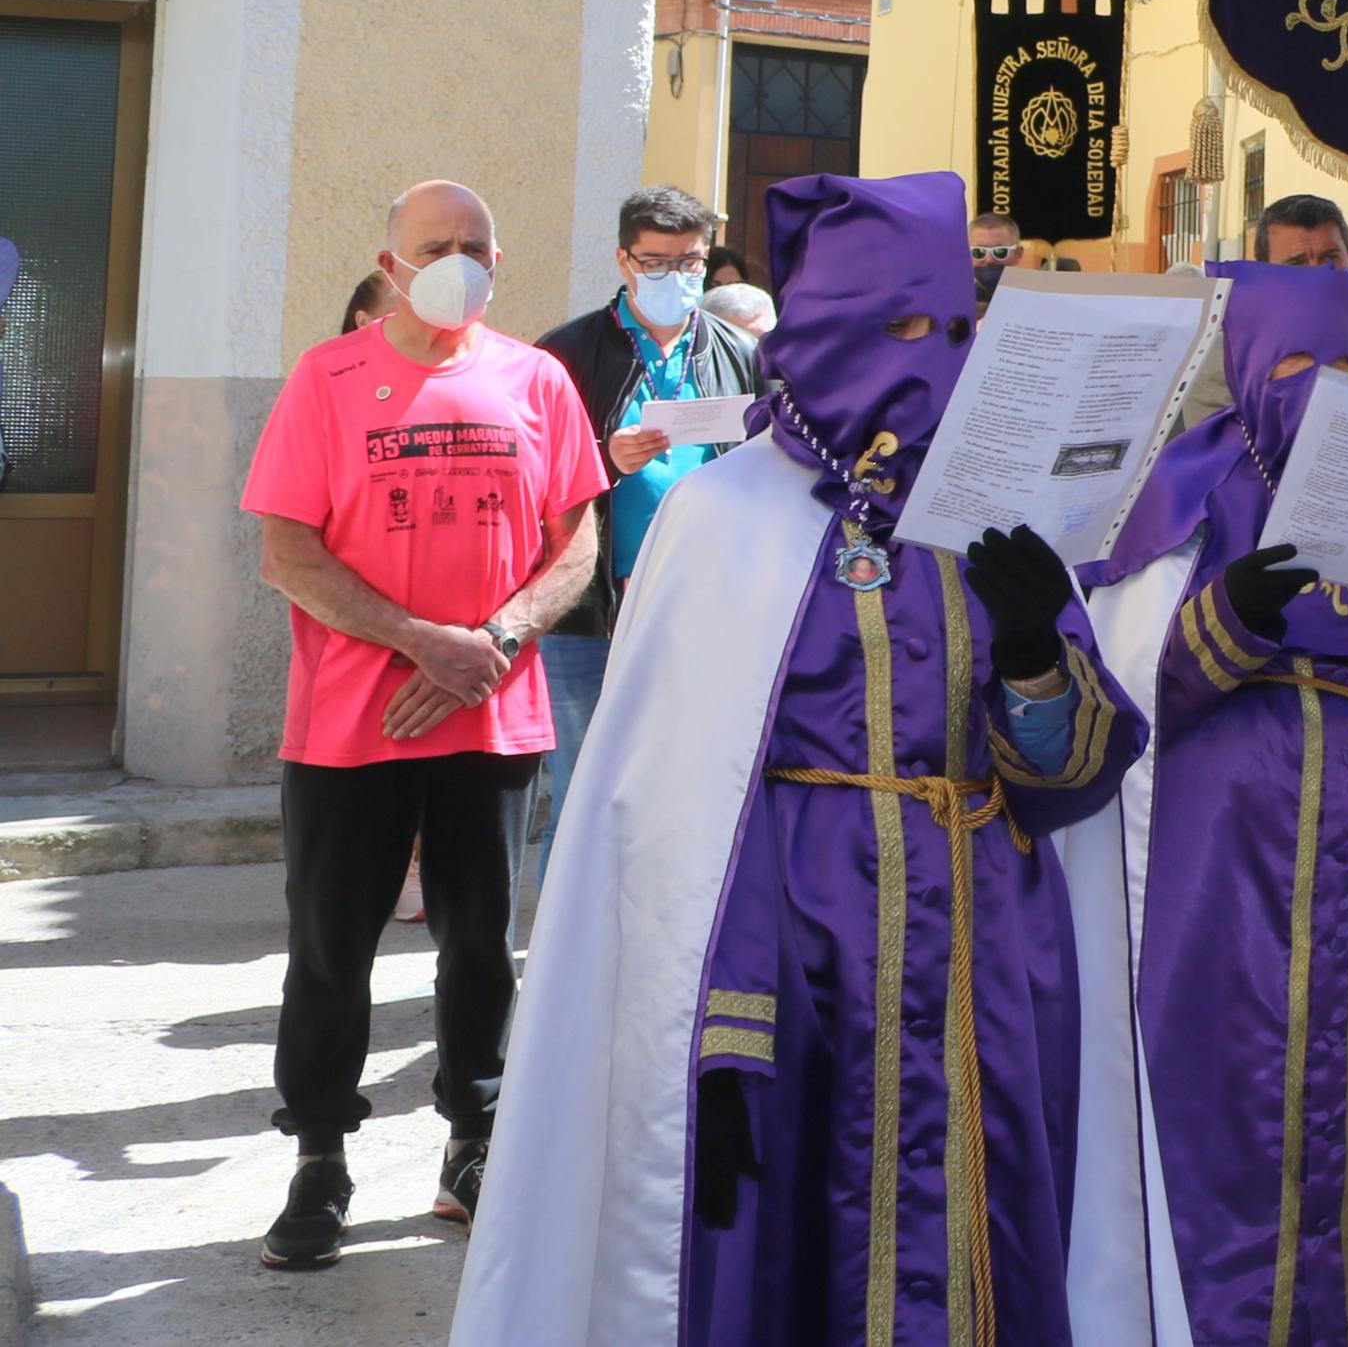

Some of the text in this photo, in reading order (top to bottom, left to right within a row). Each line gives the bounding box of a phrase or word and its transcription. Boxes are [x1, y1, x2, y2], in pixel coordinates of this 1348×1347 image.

[988, 36, 1105, 218] COFRADÍA NUESTRA SEÑORA DE LA SOLEDAD
[413, 430, 453, 445] MEDIA
